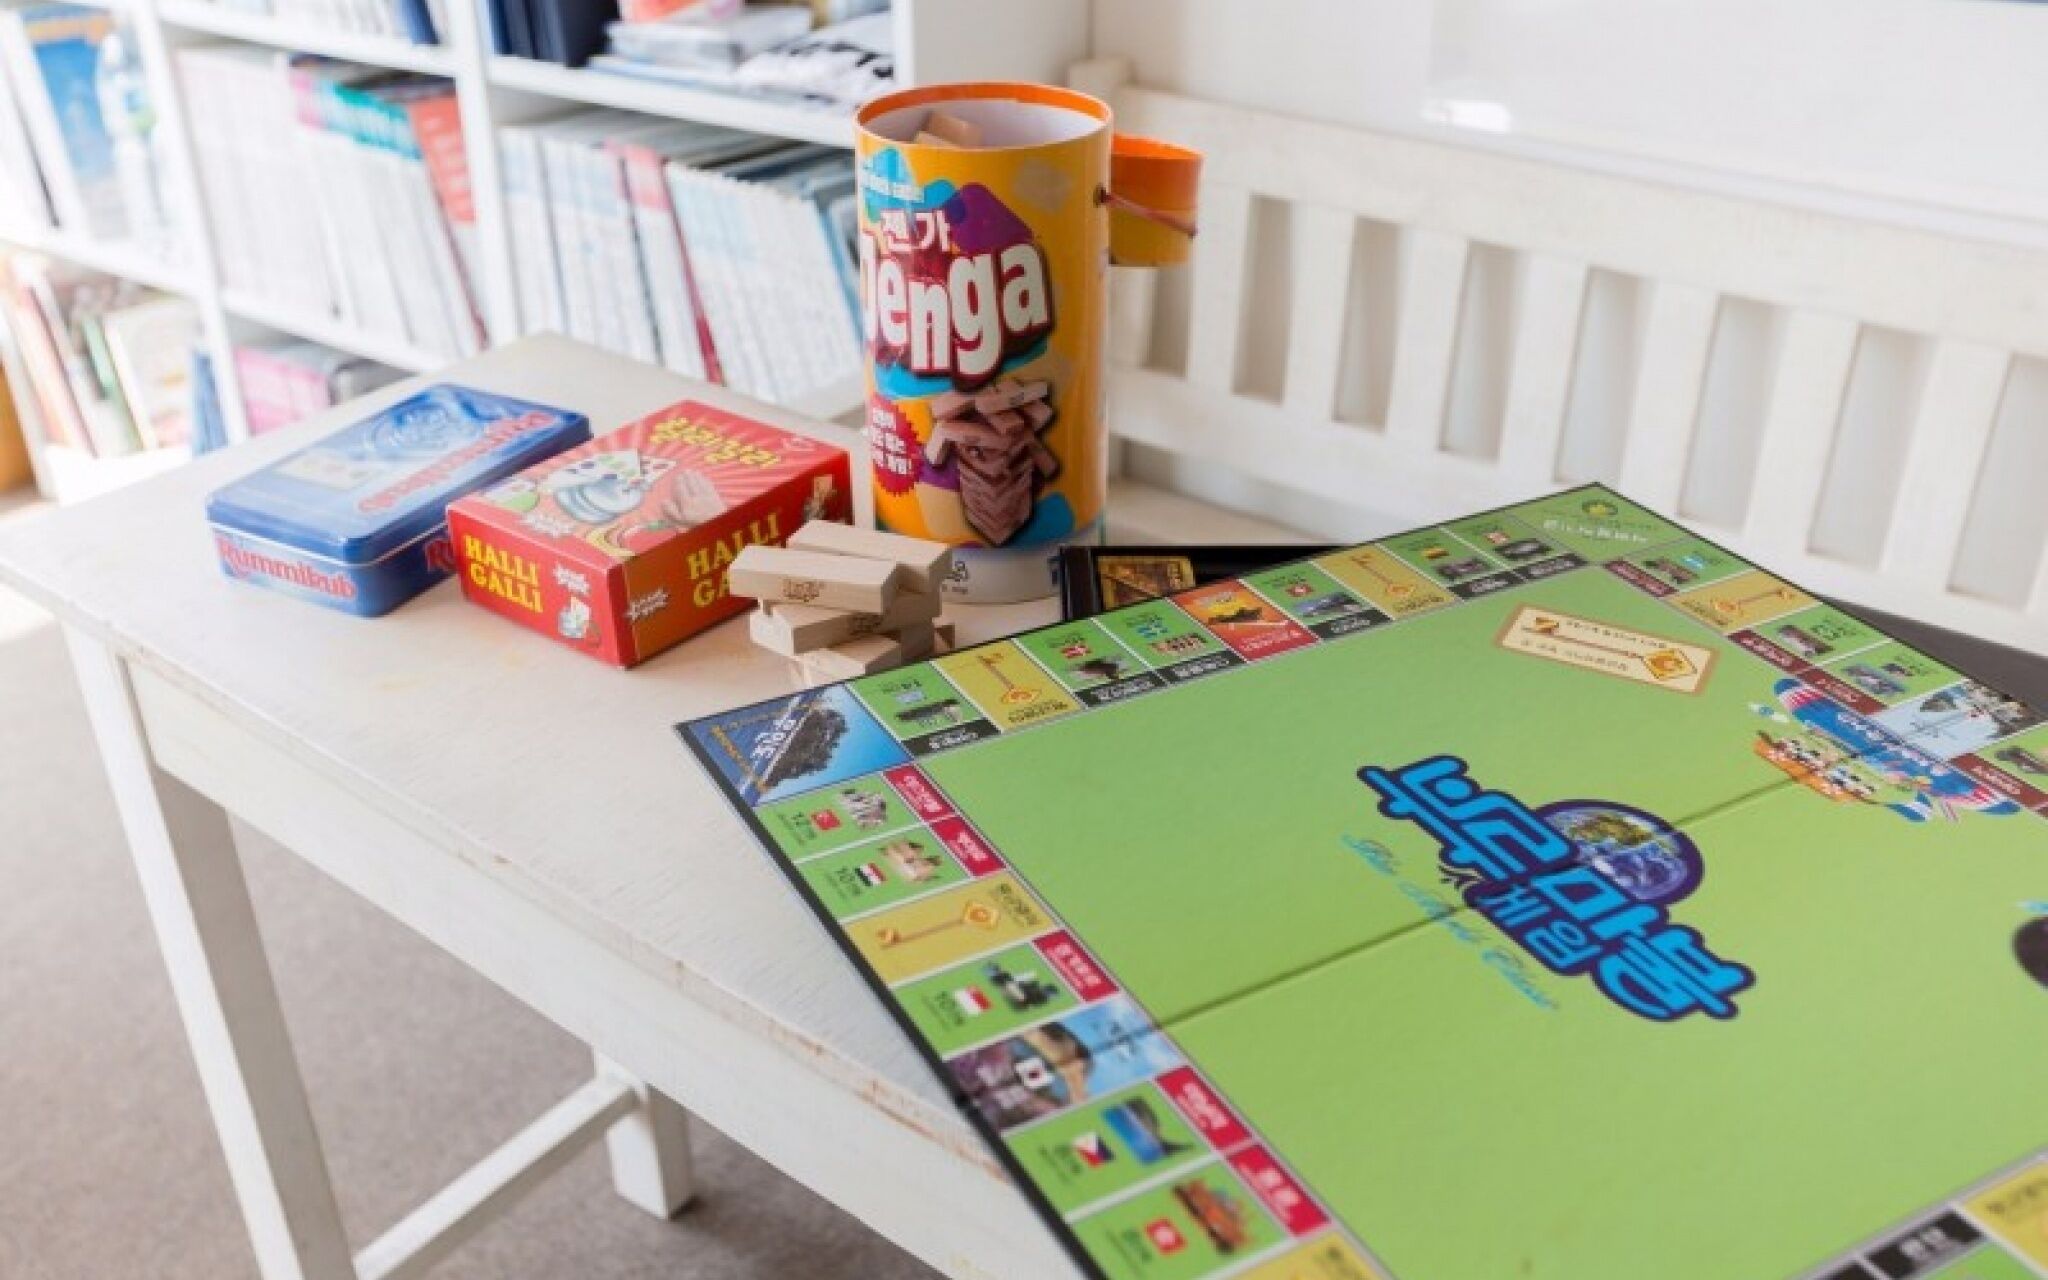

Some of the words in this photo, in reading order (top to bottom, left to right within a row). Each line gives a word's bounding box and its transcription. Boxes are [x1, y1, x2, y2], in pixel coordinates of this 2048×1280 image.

[880, 208, 951, 252] 젠가
[216, 536, 357, 600] Rummikub
[464, 534, 539, 586] HALLI
[469, 562, 544, 614] GALLI
[1474, 882, 1603, 970] 게임
